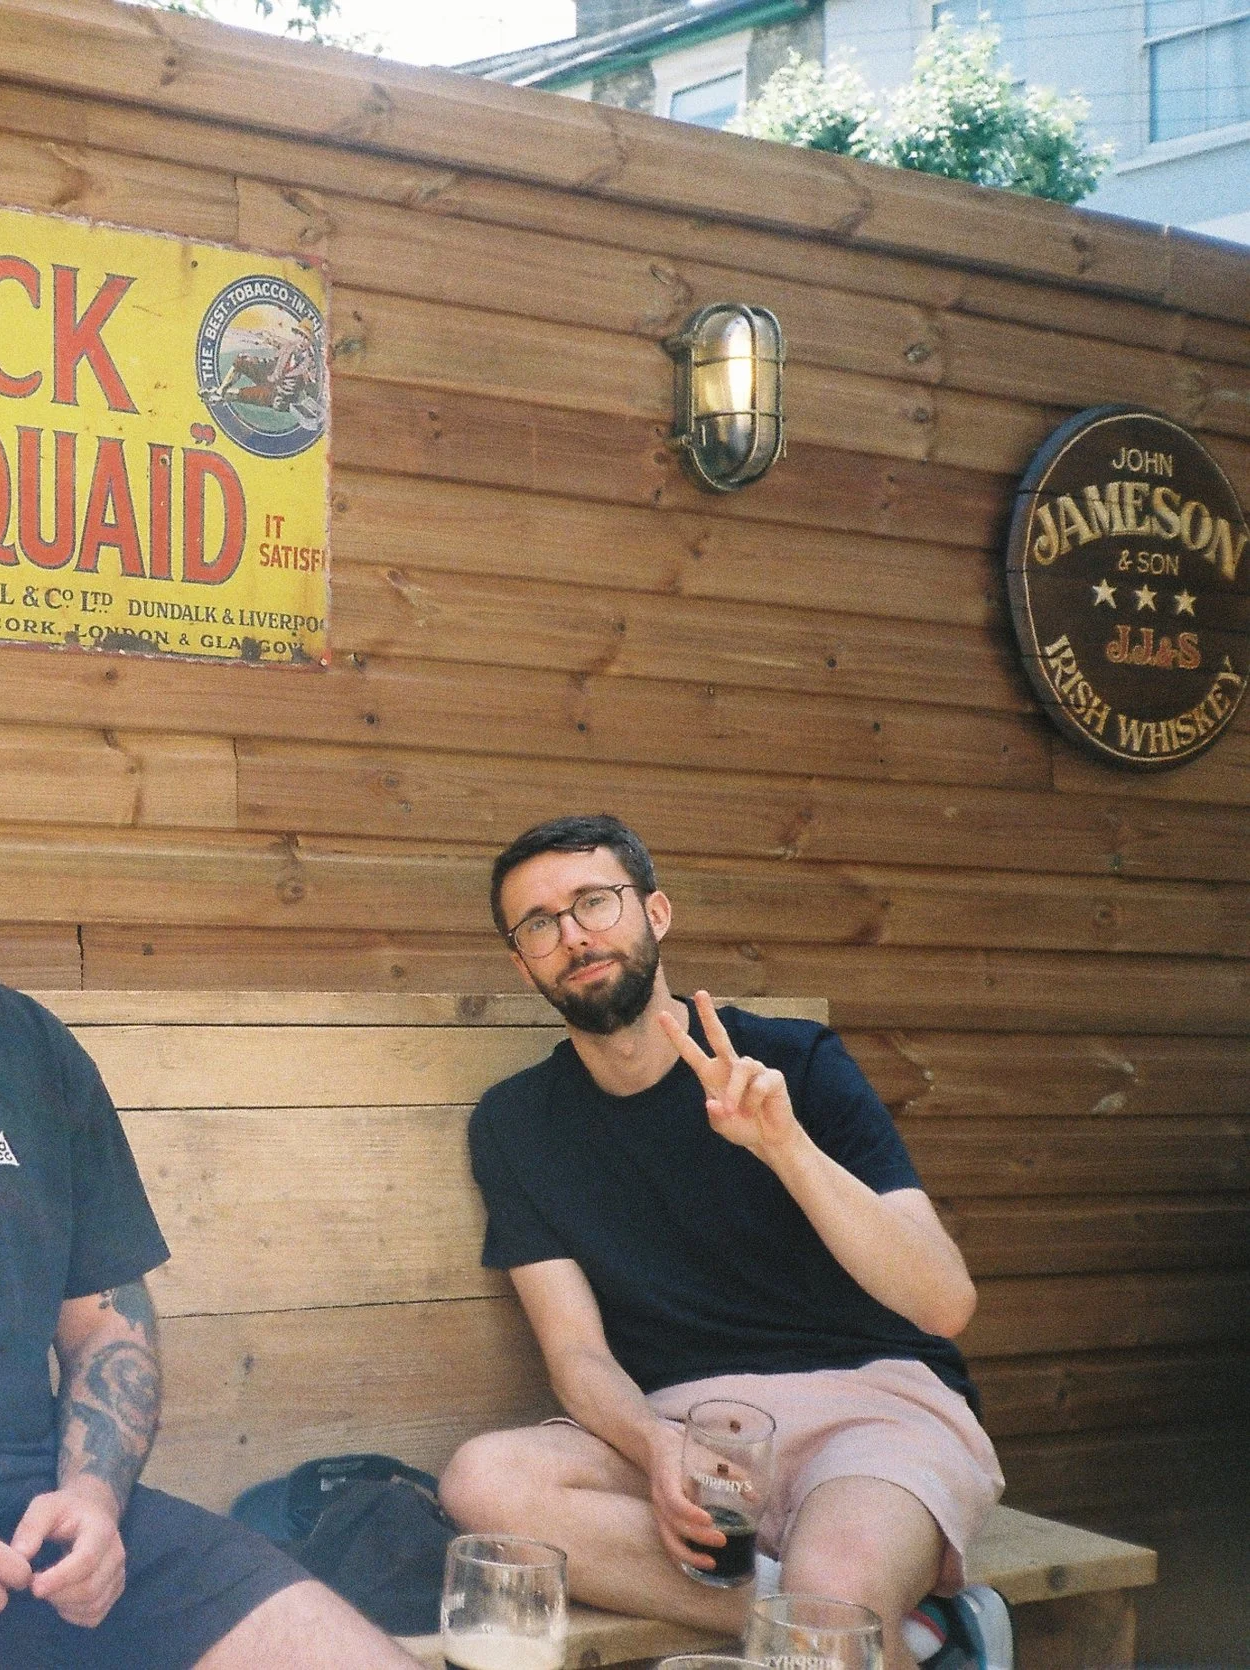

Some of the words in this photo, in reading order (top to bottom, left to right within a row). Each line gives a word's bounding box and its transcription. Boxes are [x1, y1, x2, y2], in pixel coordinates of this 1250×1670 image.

[228, 283, 289, 307] TOBACCO
[291, 295, 305, 314] IN
[206, 305, 229, 340] BEST
[202, 351, 213, 381] THE
[1112, 447, 1175, 478] JOHN
[265, 513, 286, 539] IT
[1033, 480, 1249, 583] JAMESON
[1118, 549, 1133, 571] &
[1137, 552, 1180, 577] SON
[22, 585, 40, 608] &
[128, 598, 218, 624] DUNDALK
[222, 608, 235, 626] &
[179, 632, 191, 647] &
[1044, 634, 1112, 736] IRISH
[1117, 655, 1243, 754] WHISKEY
